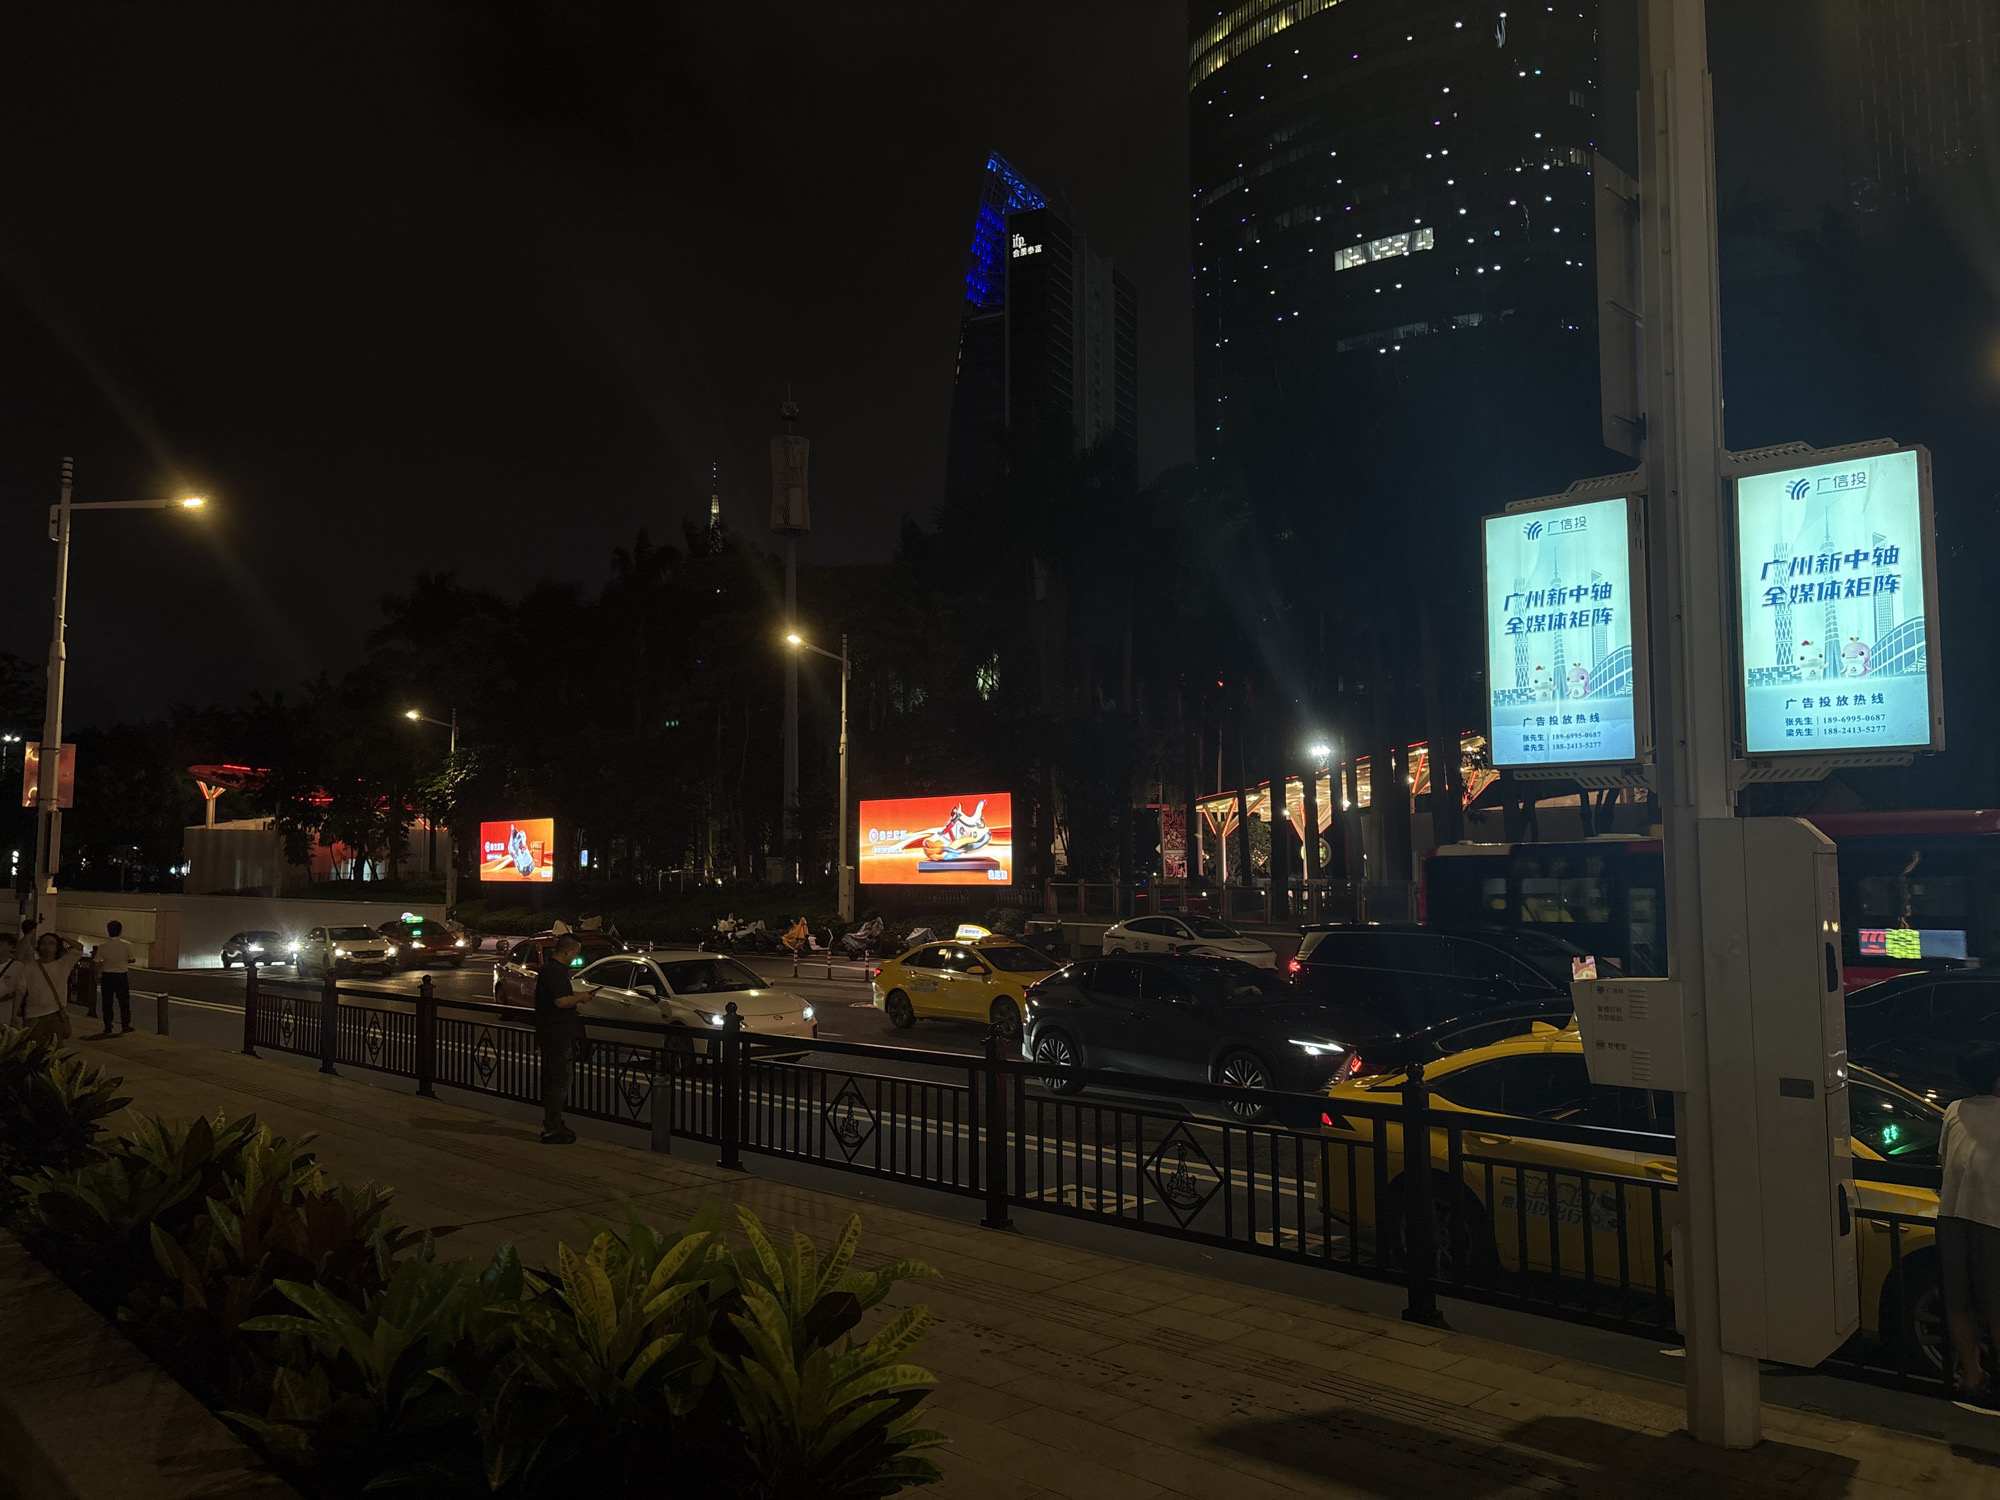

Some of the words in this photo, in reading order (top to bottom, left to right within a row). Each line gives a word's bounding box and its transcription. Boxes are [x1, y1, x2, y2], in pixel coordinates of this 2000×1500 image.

[1816, 471, 1867, 492] 广信投
[1547, 516, 1587, 532] 广信投
[1760, 545, 1900, 581] 广州新中轴
[1504, 581, 1613, 611] 广州新中轴
[1762, 574, 1902, 607] 全媒体矩阵
[1505, 607, 1614, 635] 全媒体矩阵
[1785, 692, 1885, 710] 广告投放热线
[1522, 714, 1601, 728] 广告投放热线
[1785, 716, 1813, 726] 张先生
[1823, 714, 1886, 724] 189-6995-0687
[1522, 733, 1545, 742] 张先生
[1785, 727, 1813, 737] 梁先生
[1823, 725, 1886, 735] 188-2413-5277
